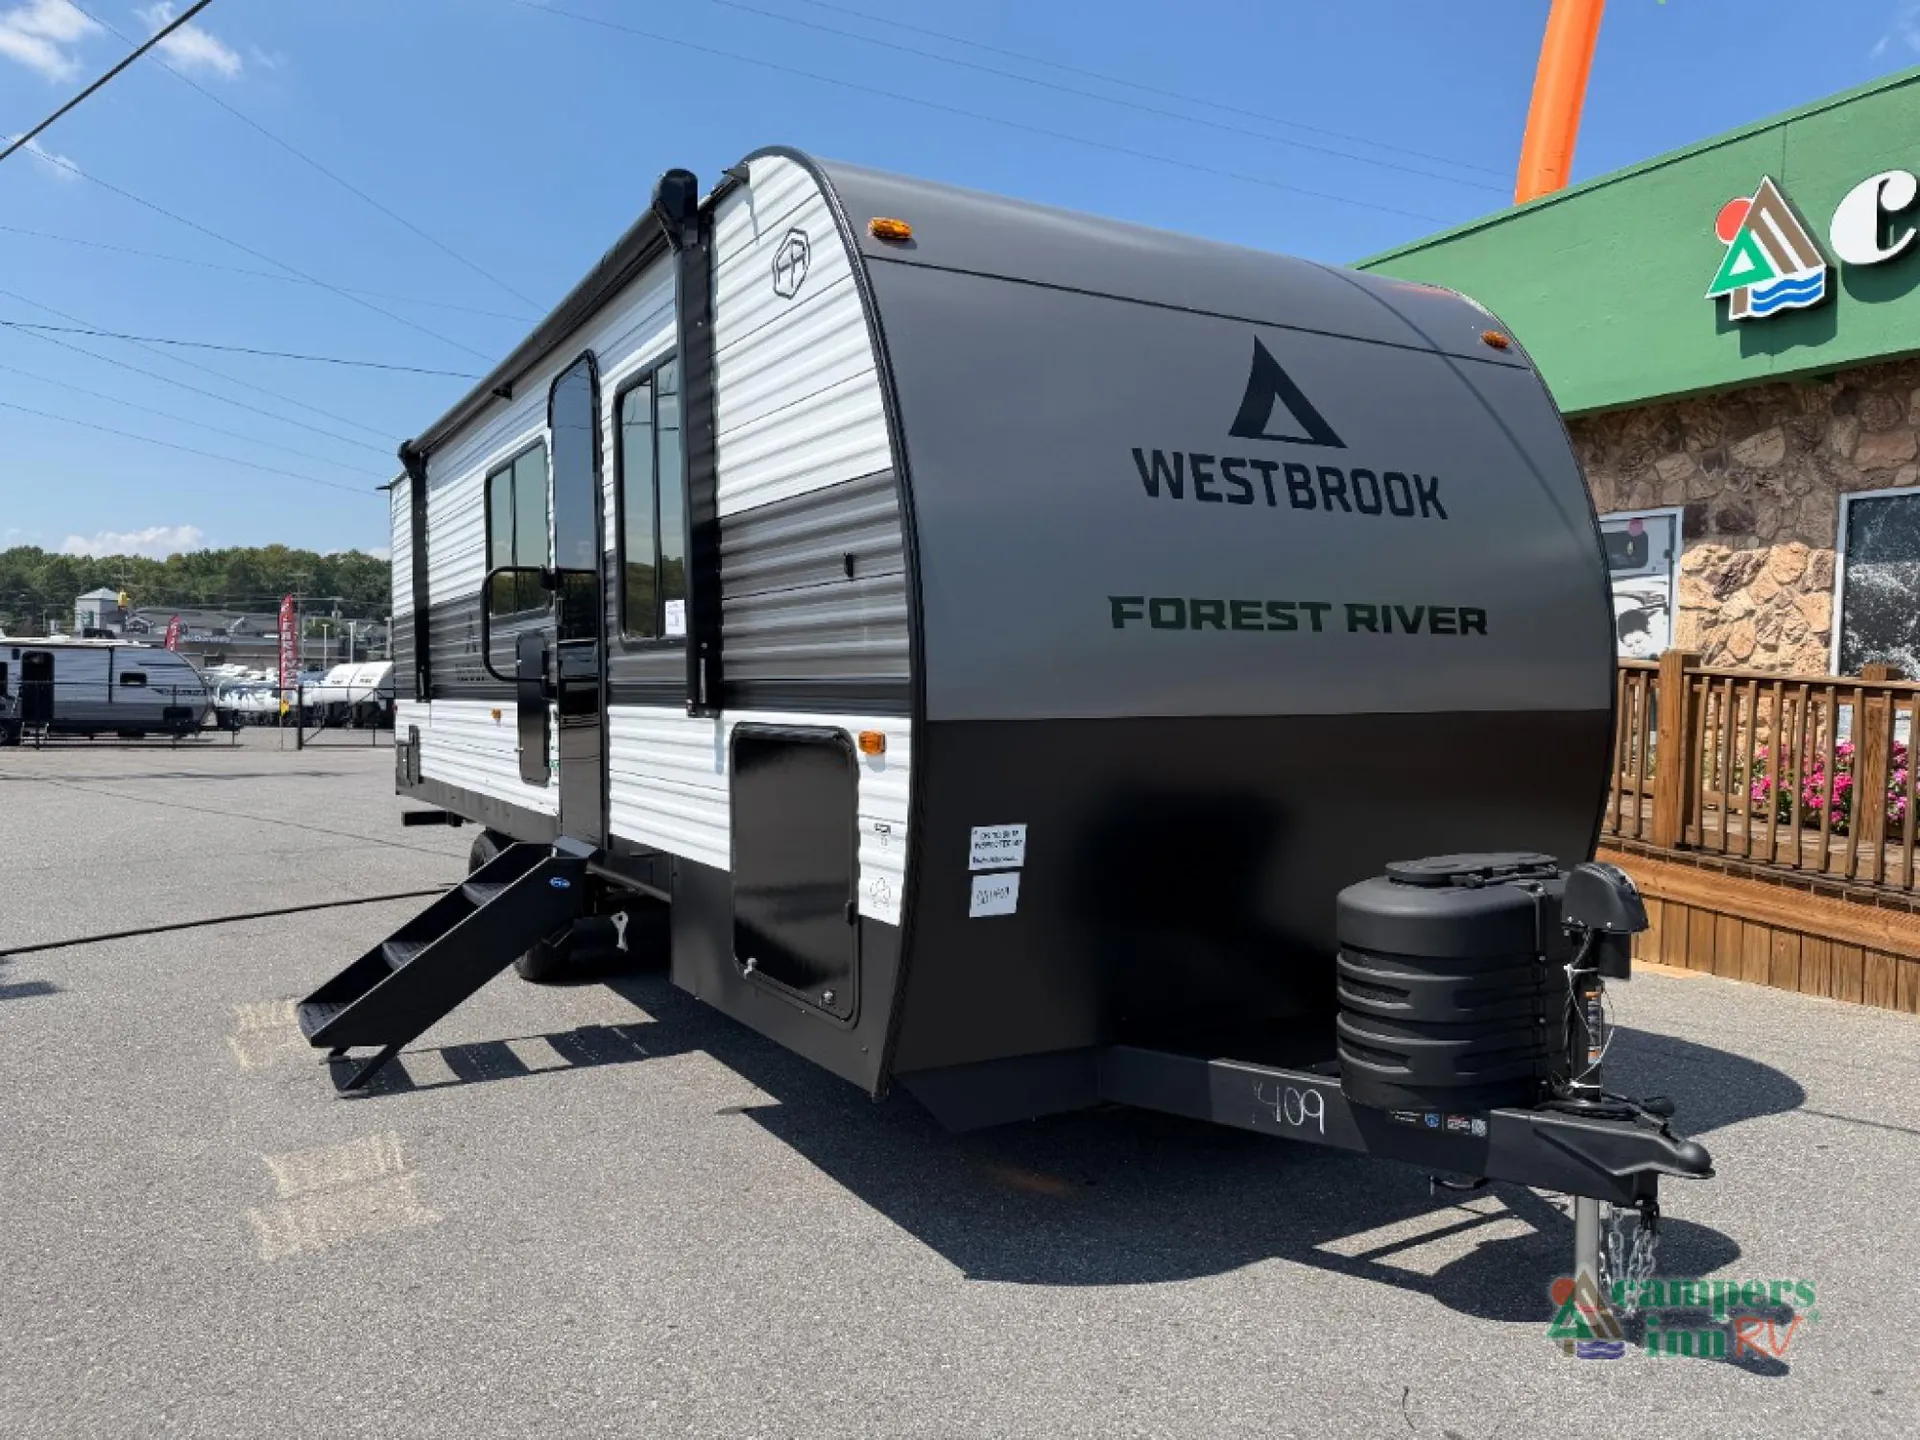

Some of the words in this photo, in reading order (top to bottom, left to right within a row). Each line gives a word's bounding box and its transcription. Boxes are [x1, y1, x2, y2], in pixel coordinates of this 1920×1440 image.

[1131, 447, 1449, 520] WESTBROOK
[1108, 596, 1332, 632] FOREST
[1344, 603, 1488, 635] RIVER
